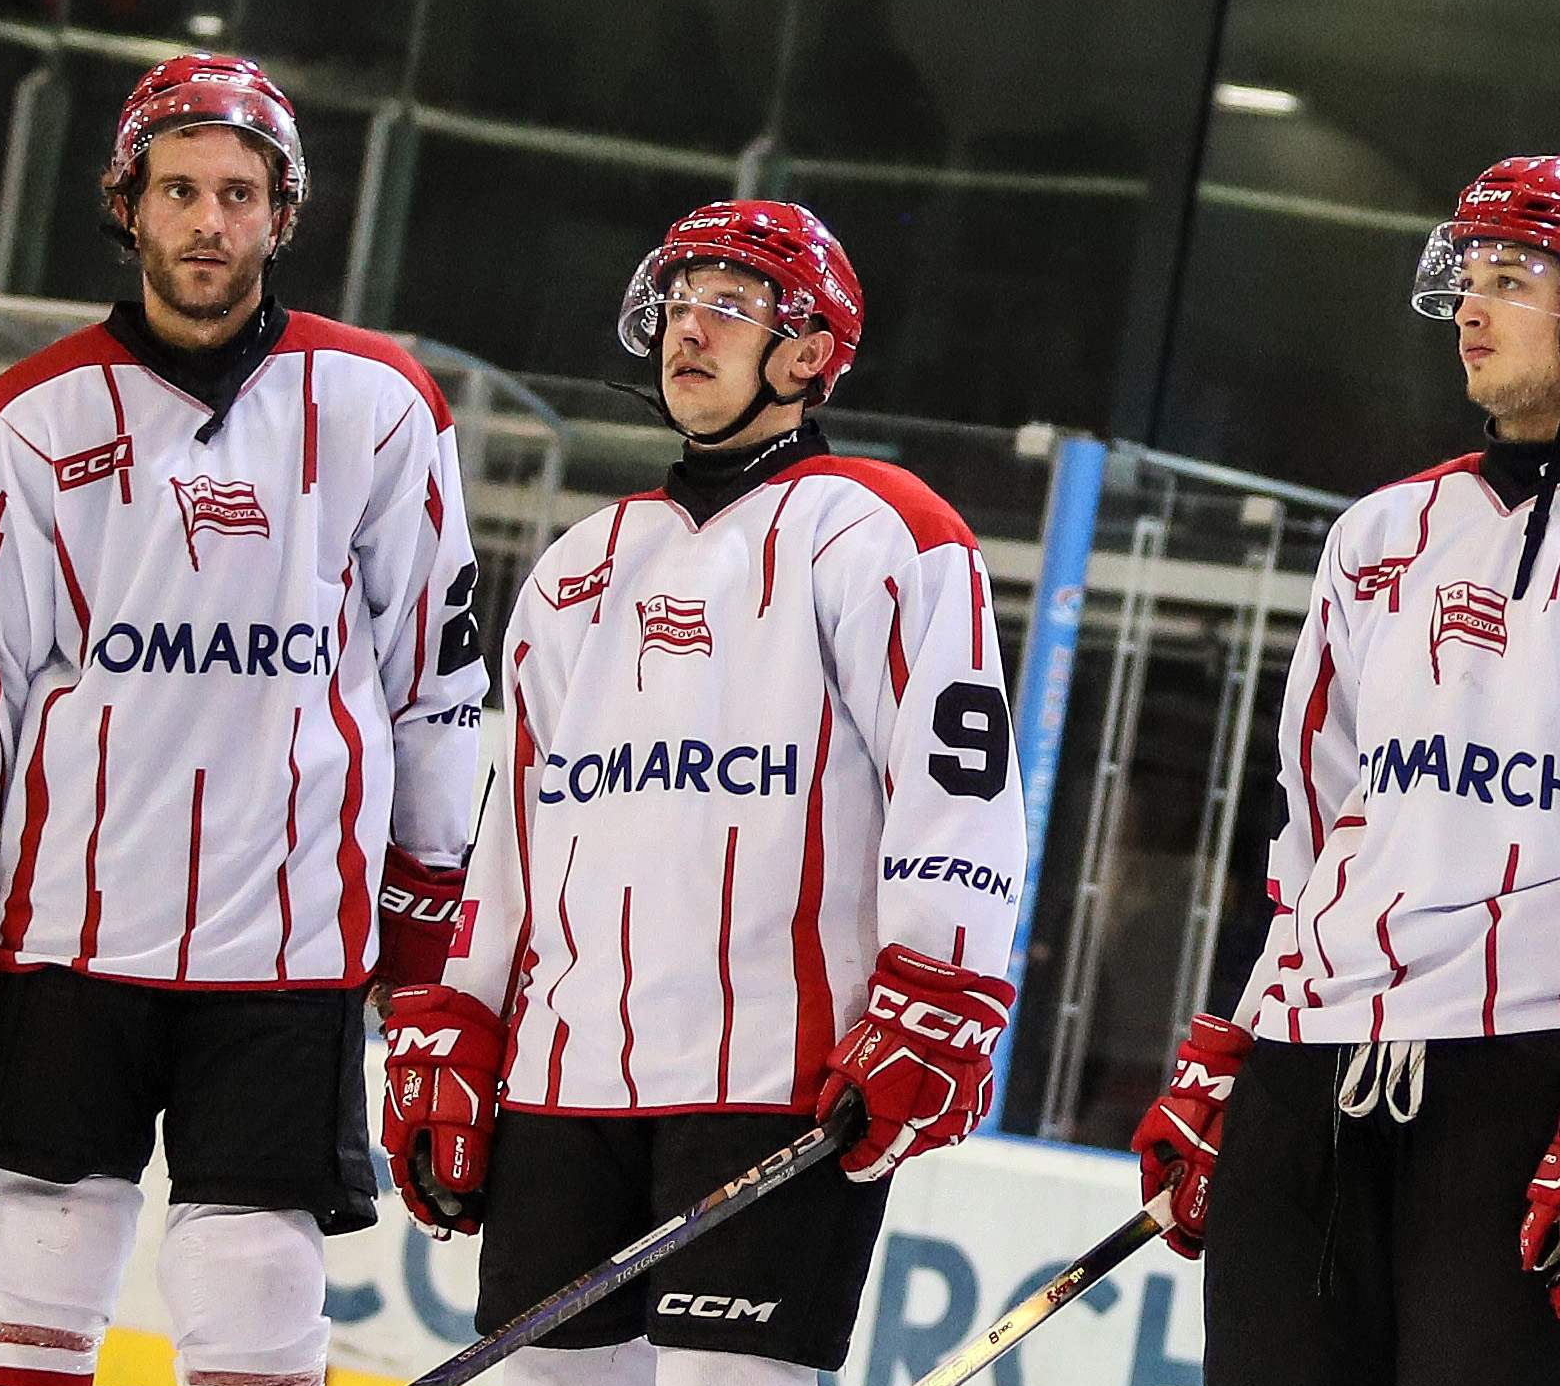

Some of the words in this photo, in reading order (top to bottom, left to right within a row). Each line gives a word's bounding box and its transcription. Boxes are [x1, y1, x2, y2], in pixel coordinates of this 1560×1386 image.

[192, 73, 253, 87] CCM
[1466, 189, 1513, 205] CCM
[678, 216, 731, 233] CCM
[824, 276, 859, 315] CCM
[198, 502, 258, 519] CRACOVIA
[1446, 588, 1464, 601] KS
[647, 623, 704, 639] CRACOVIA
[93, 621, 331, 675] OMARCH
[427, 706, 481, 729] WER
[929, 681, 1011, 803] 9
[883, 854, 1013, 899] WERON
[868, 984, 1003, 1056] CCM
[452, 1135, 466, 1180] CCM
[614, 1239, 678, 1284] TRIGGER
[655, 1293, 783, 1324] CCM
